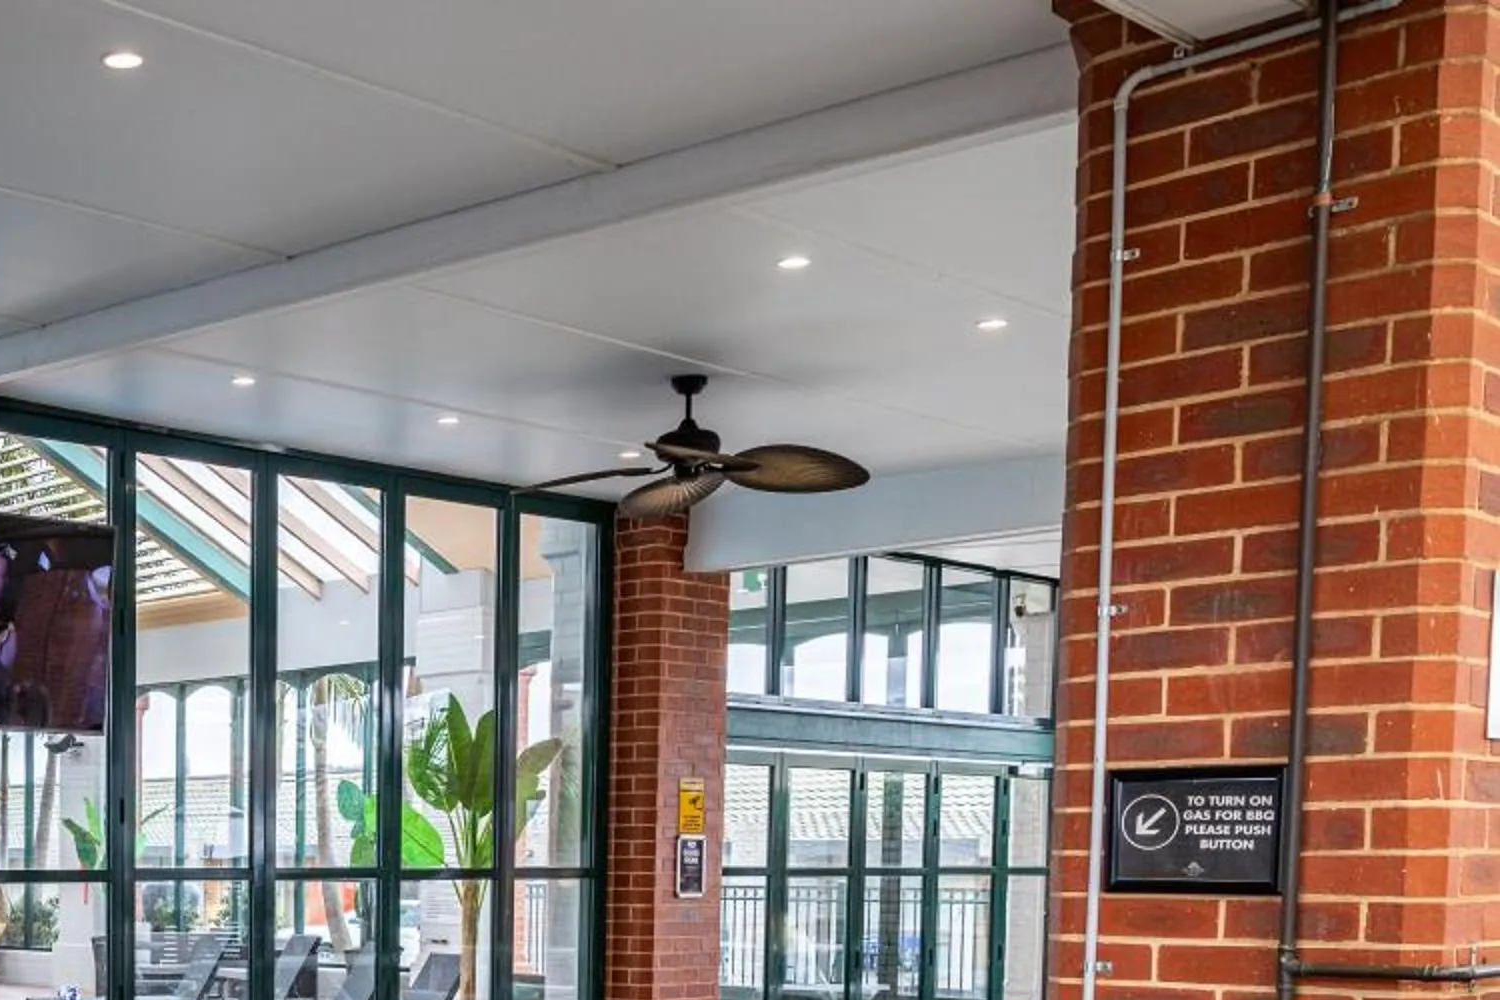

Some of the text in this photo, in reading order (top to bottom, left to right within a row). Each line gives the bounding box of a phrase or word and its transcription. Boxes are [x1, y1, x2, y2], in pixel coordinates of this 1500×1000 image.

[1187, 795, 1273, 807] TO TURN ON
[1183, 809, 1275, 821] GAS FOR BBQ
[1185, 825, 1271, 835] PLEASE PUSH
[1200, 839, 1254, 850] BUTTON
